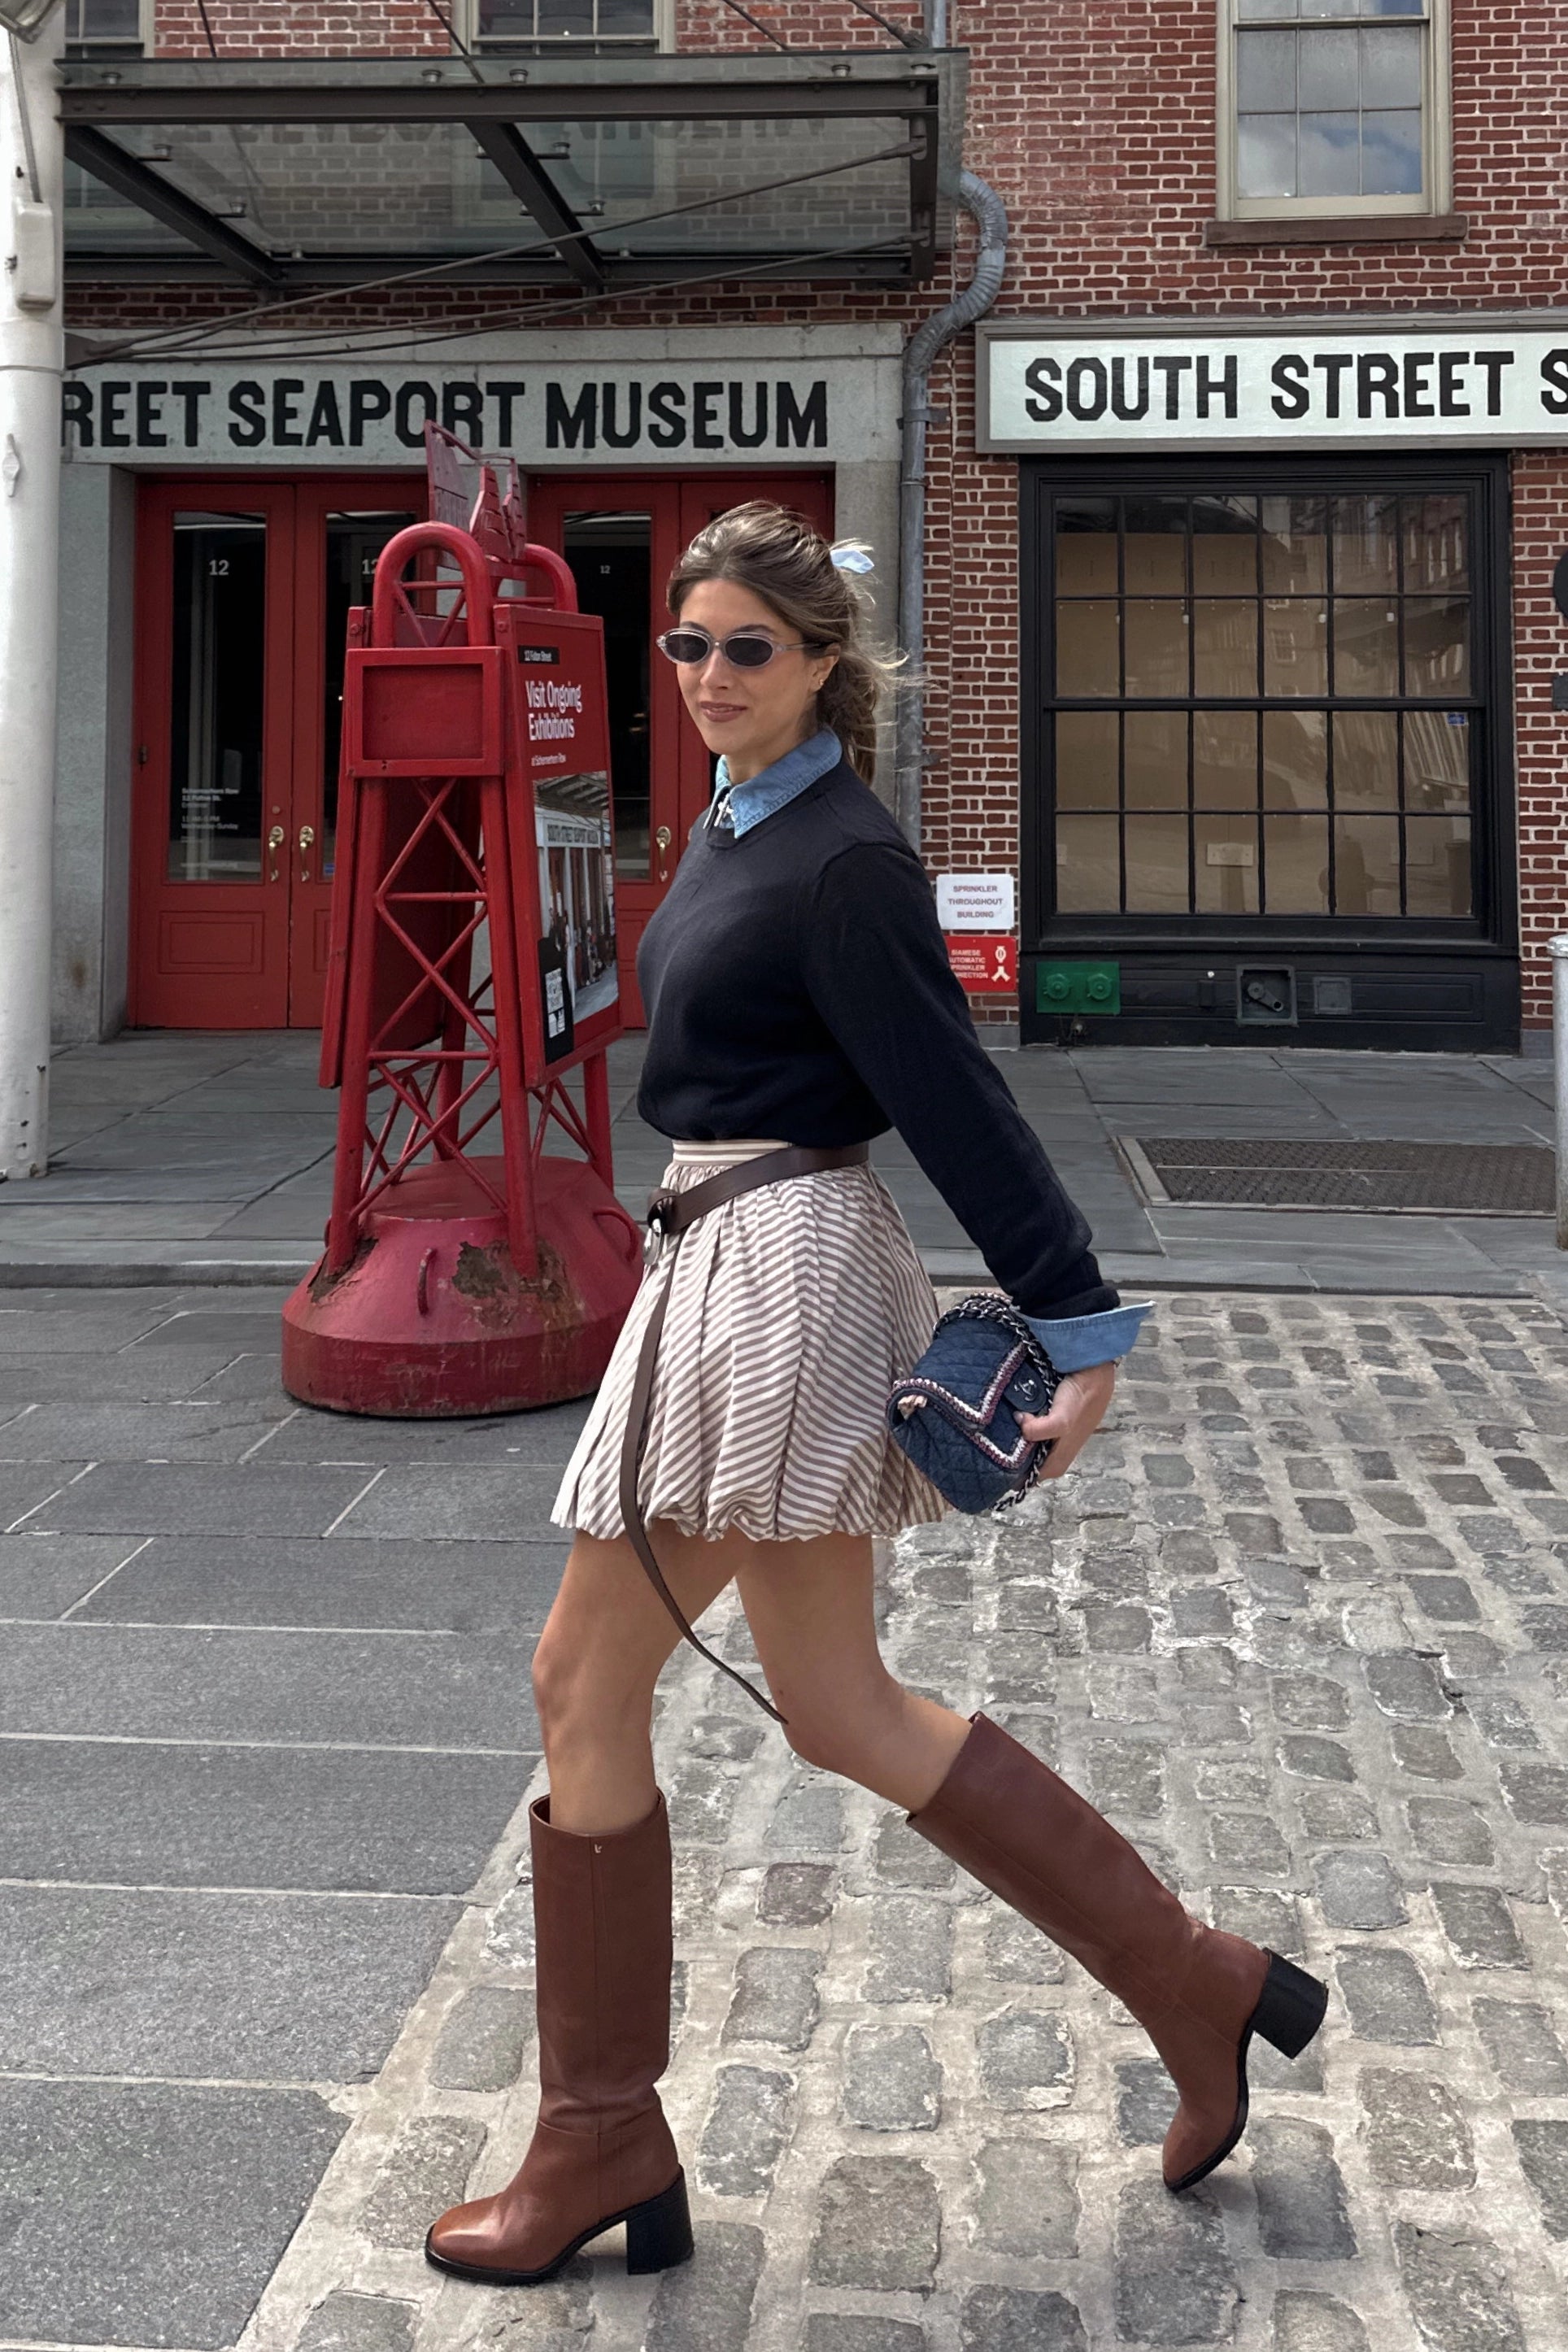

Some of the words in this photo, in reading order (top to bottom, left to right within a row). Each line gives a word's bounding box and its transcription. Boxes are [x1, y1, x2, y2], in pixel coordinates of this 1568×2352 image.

[1026, 355, 1238, 422] SOUTH
[1271, 351, 1514, 419] STREET
[1540, 349, 1568, 415] S
[61, 381, 211, 447] REET
[228, 378, 525, 448] SEAPORT
[546, 381, 828, 449] MUSEUM
[209, 560, 229, 576] 12
[600, 565, 611, 574] 12
[525, 680, 546, 708] Visit
[547, 680, 582, 713] Ongoing
[529, 712, 575, 741] Exhibitions
[953, 885, 998, 893] SPRINKLER
